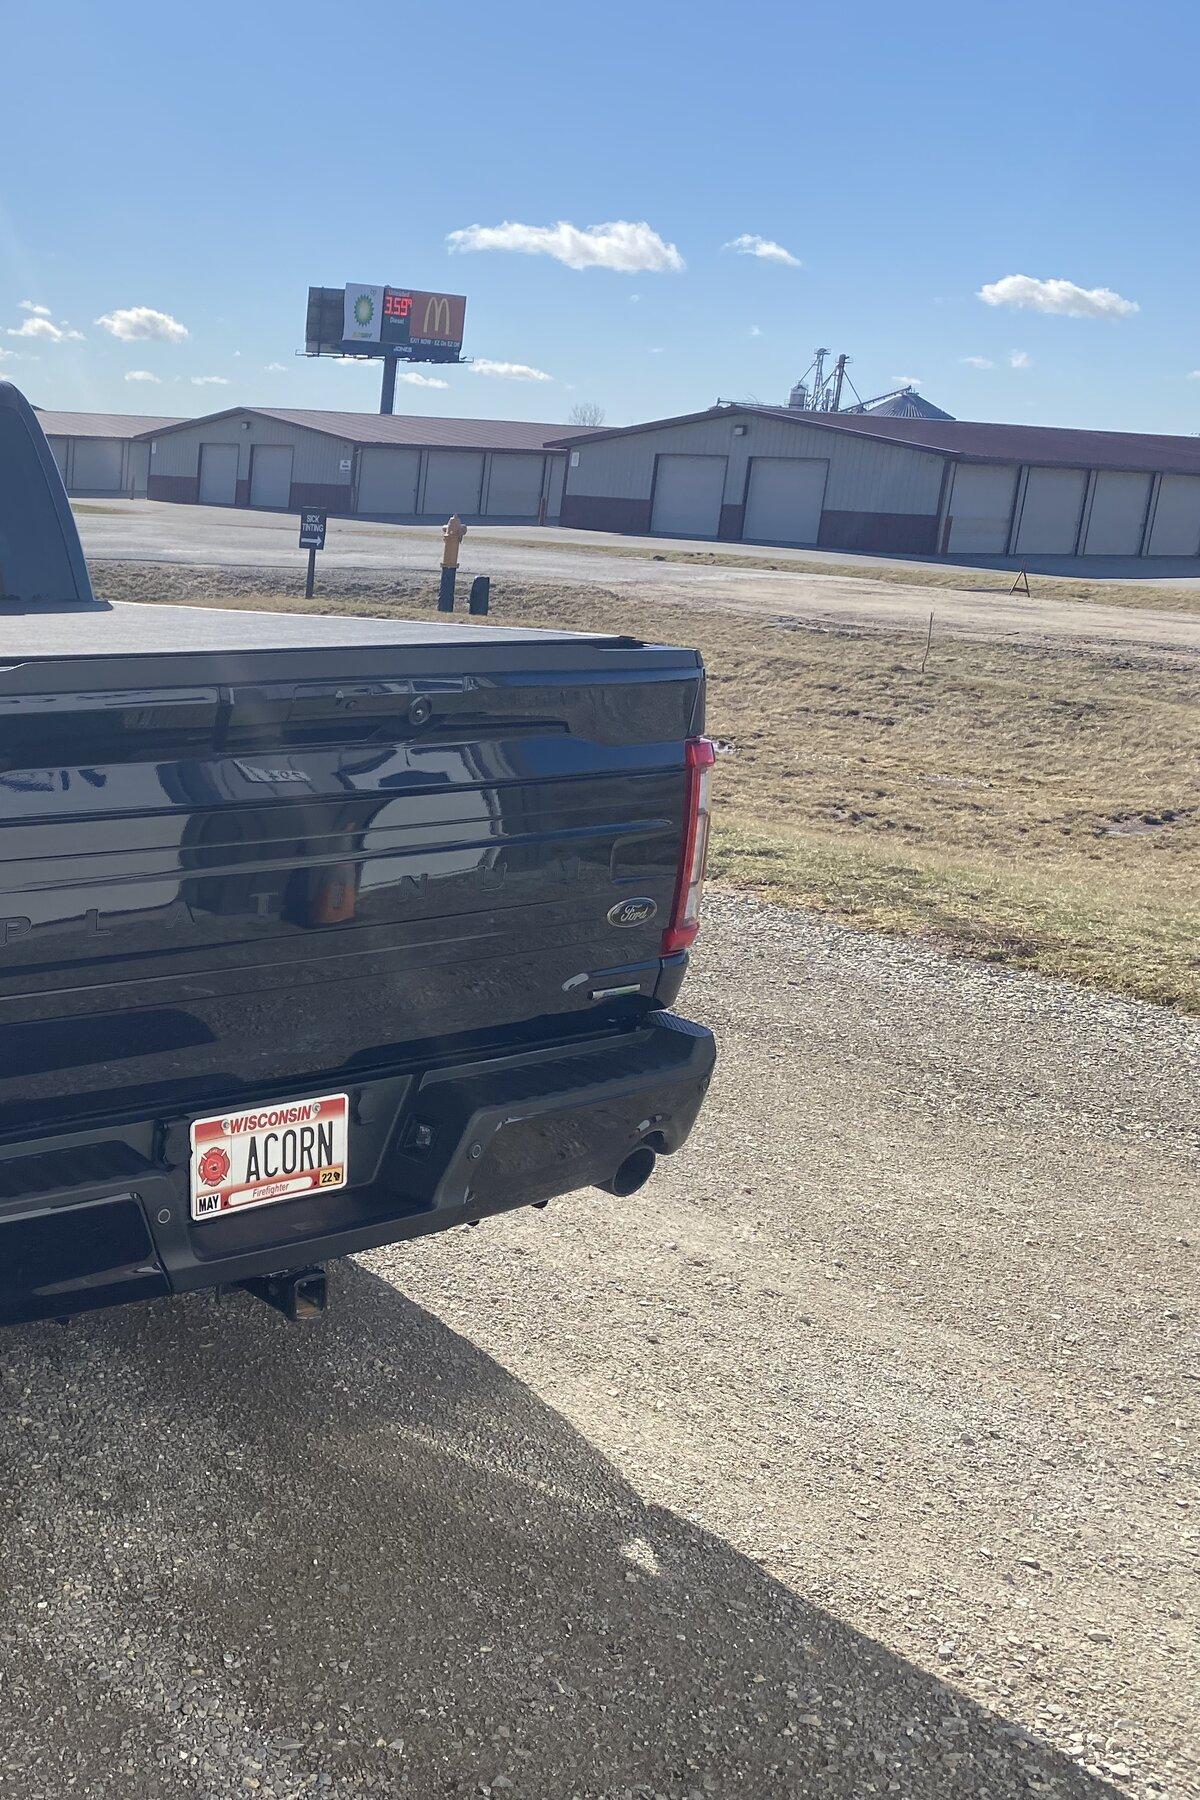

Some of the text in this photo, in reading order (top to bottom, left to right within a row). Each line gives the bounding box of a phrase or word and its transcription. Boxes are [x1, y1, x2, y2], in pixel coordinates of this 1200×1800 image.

[306, 514, 320, 523] SICK
[302, 523, 324, 533] TINTING
[230, 1104, 313, 1134] WISCONSIN
[245, 1120, 334, 1184] ACORN
[321, 1171, 333, 1184] 22
[252, 1182, 290, 1198] Firefighter
[198, 1194, 221, 1213] MAY
